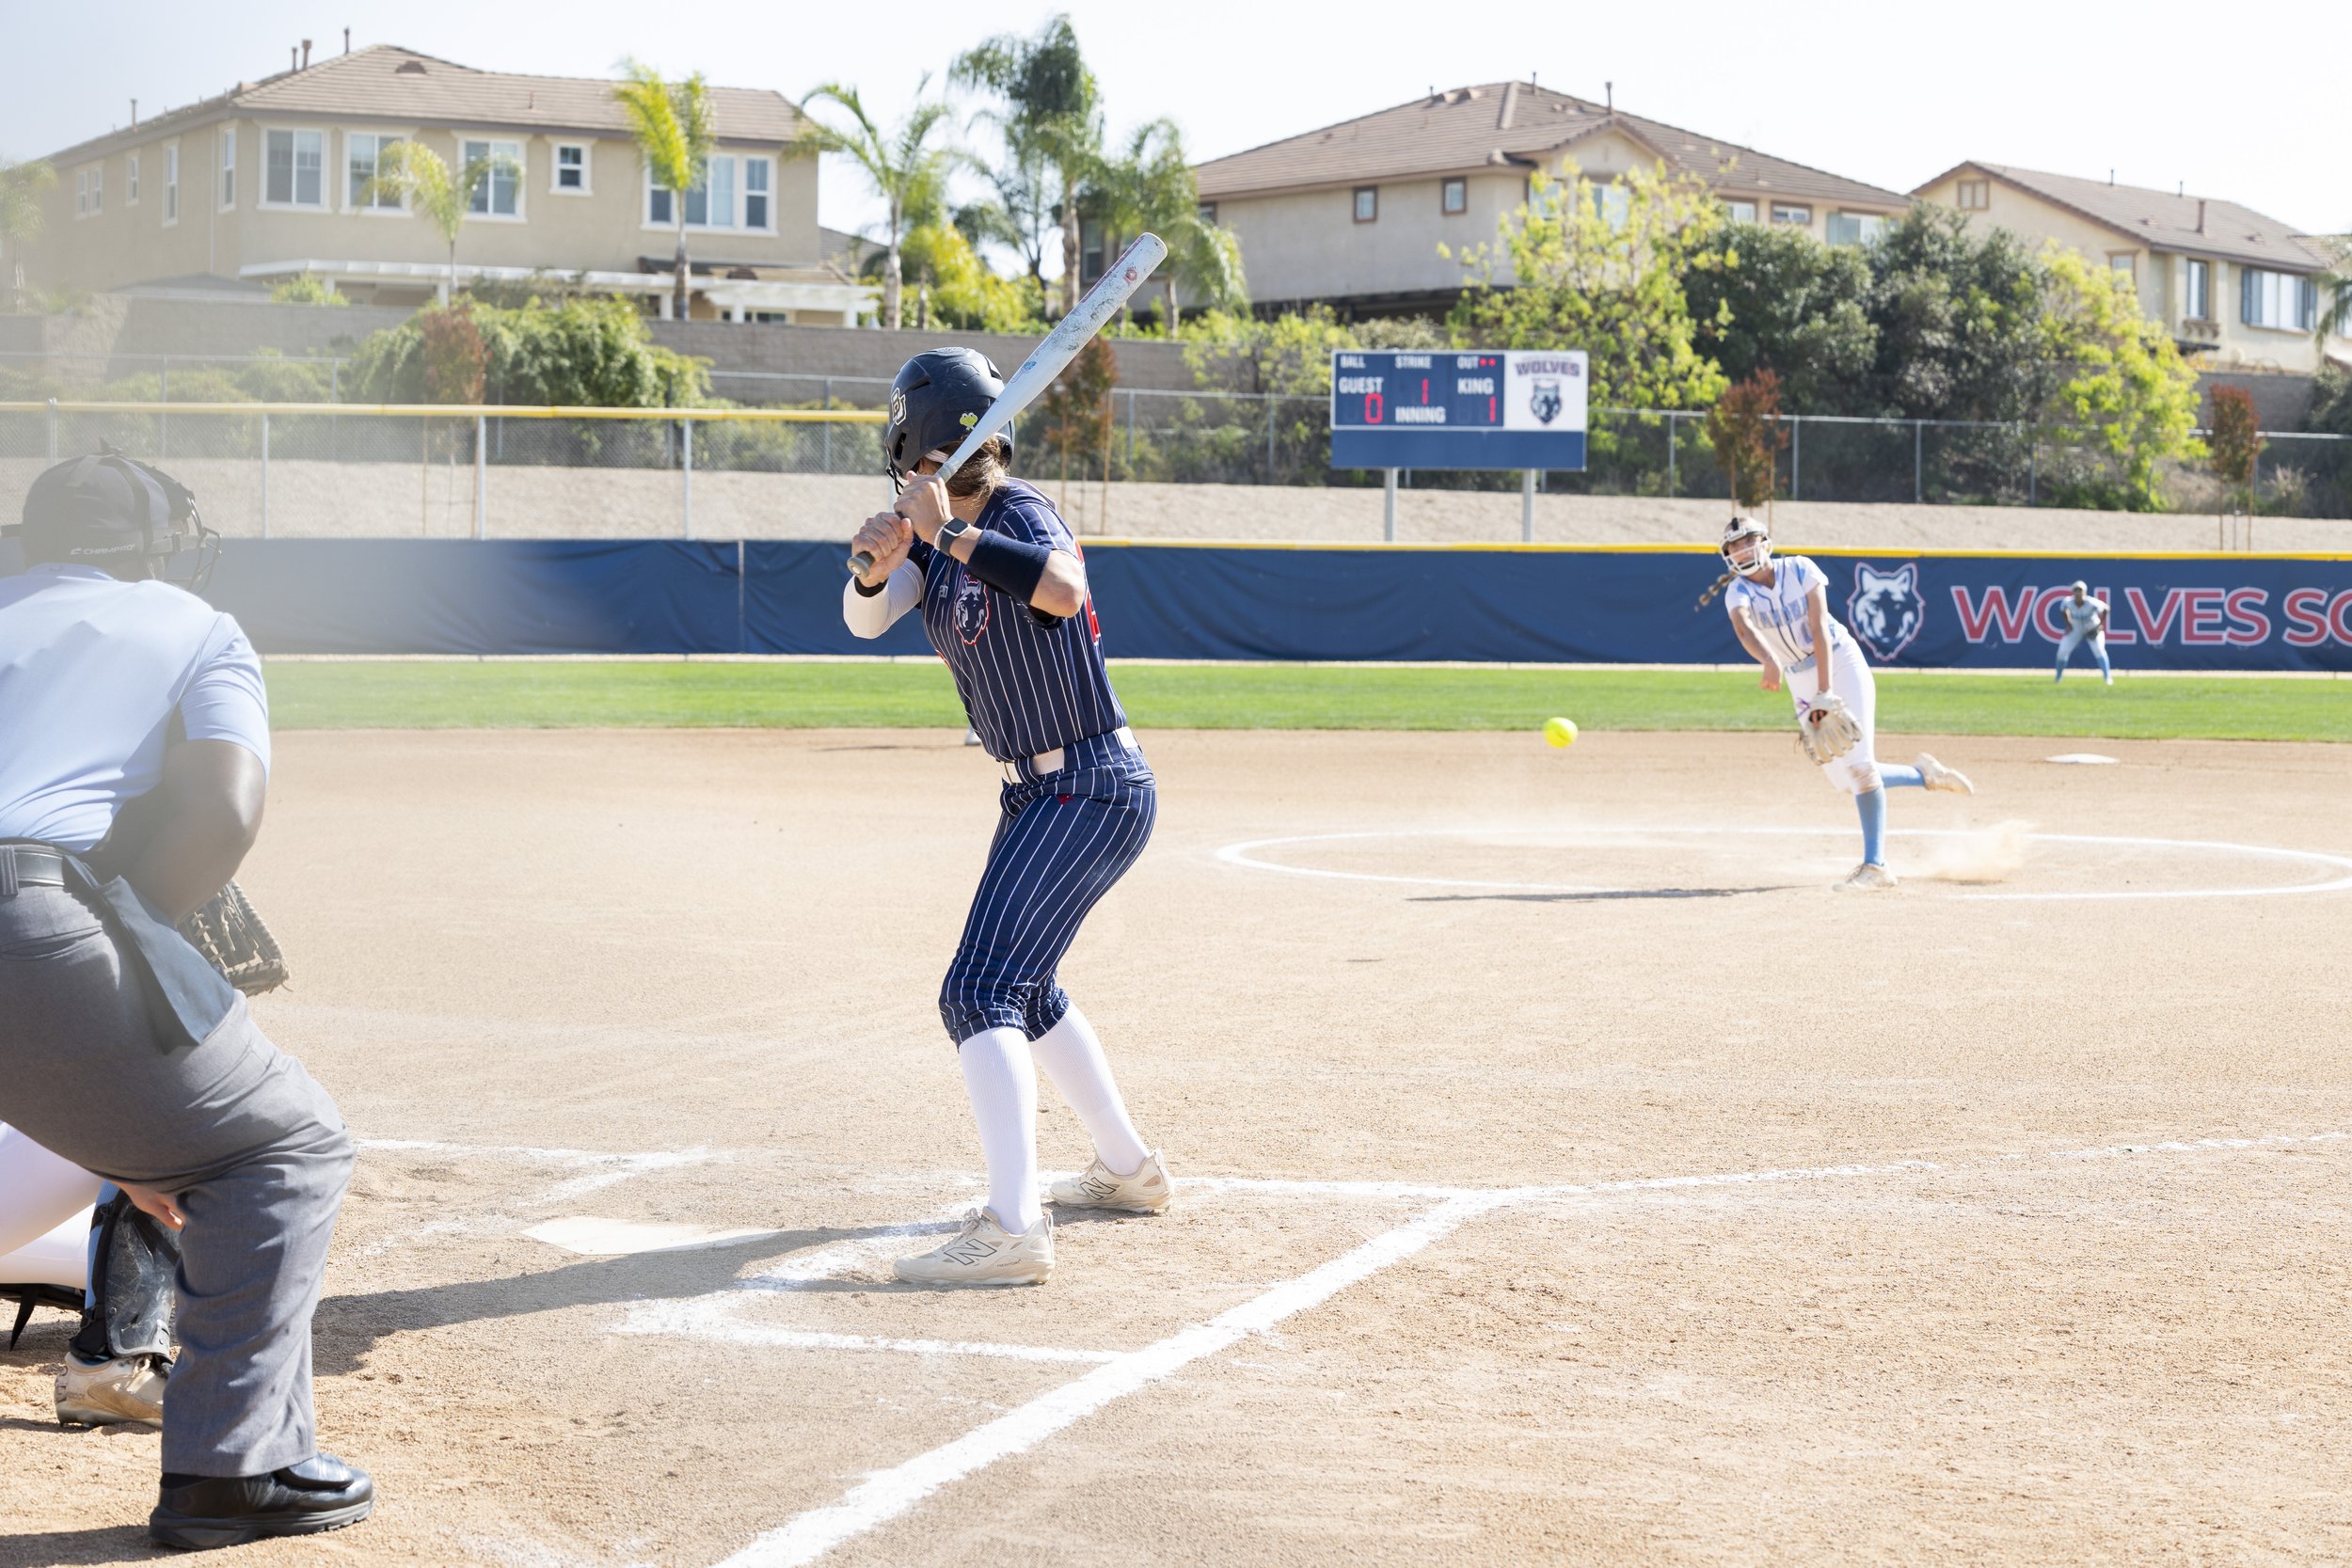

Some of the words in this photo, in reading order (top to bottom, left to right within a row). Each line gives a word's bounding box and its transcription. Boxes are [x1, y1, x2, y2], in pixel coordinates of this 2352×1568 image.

[1340, 356, 1366, 369] BALL
[1395, 356, 1433, 369] STRIKE
[1457, 356, 1479, 369] OUT
[1515, 360, 1581, 377] WOLVES
[1339, 376, 1384, 394] GUEST
[1457, 377, 1494, 394] KING
[1365, 393, 1383, 423] 0
[1395, 406, 1446, 423] INNING
[83, 544, 133, 555] CHAMPRO
